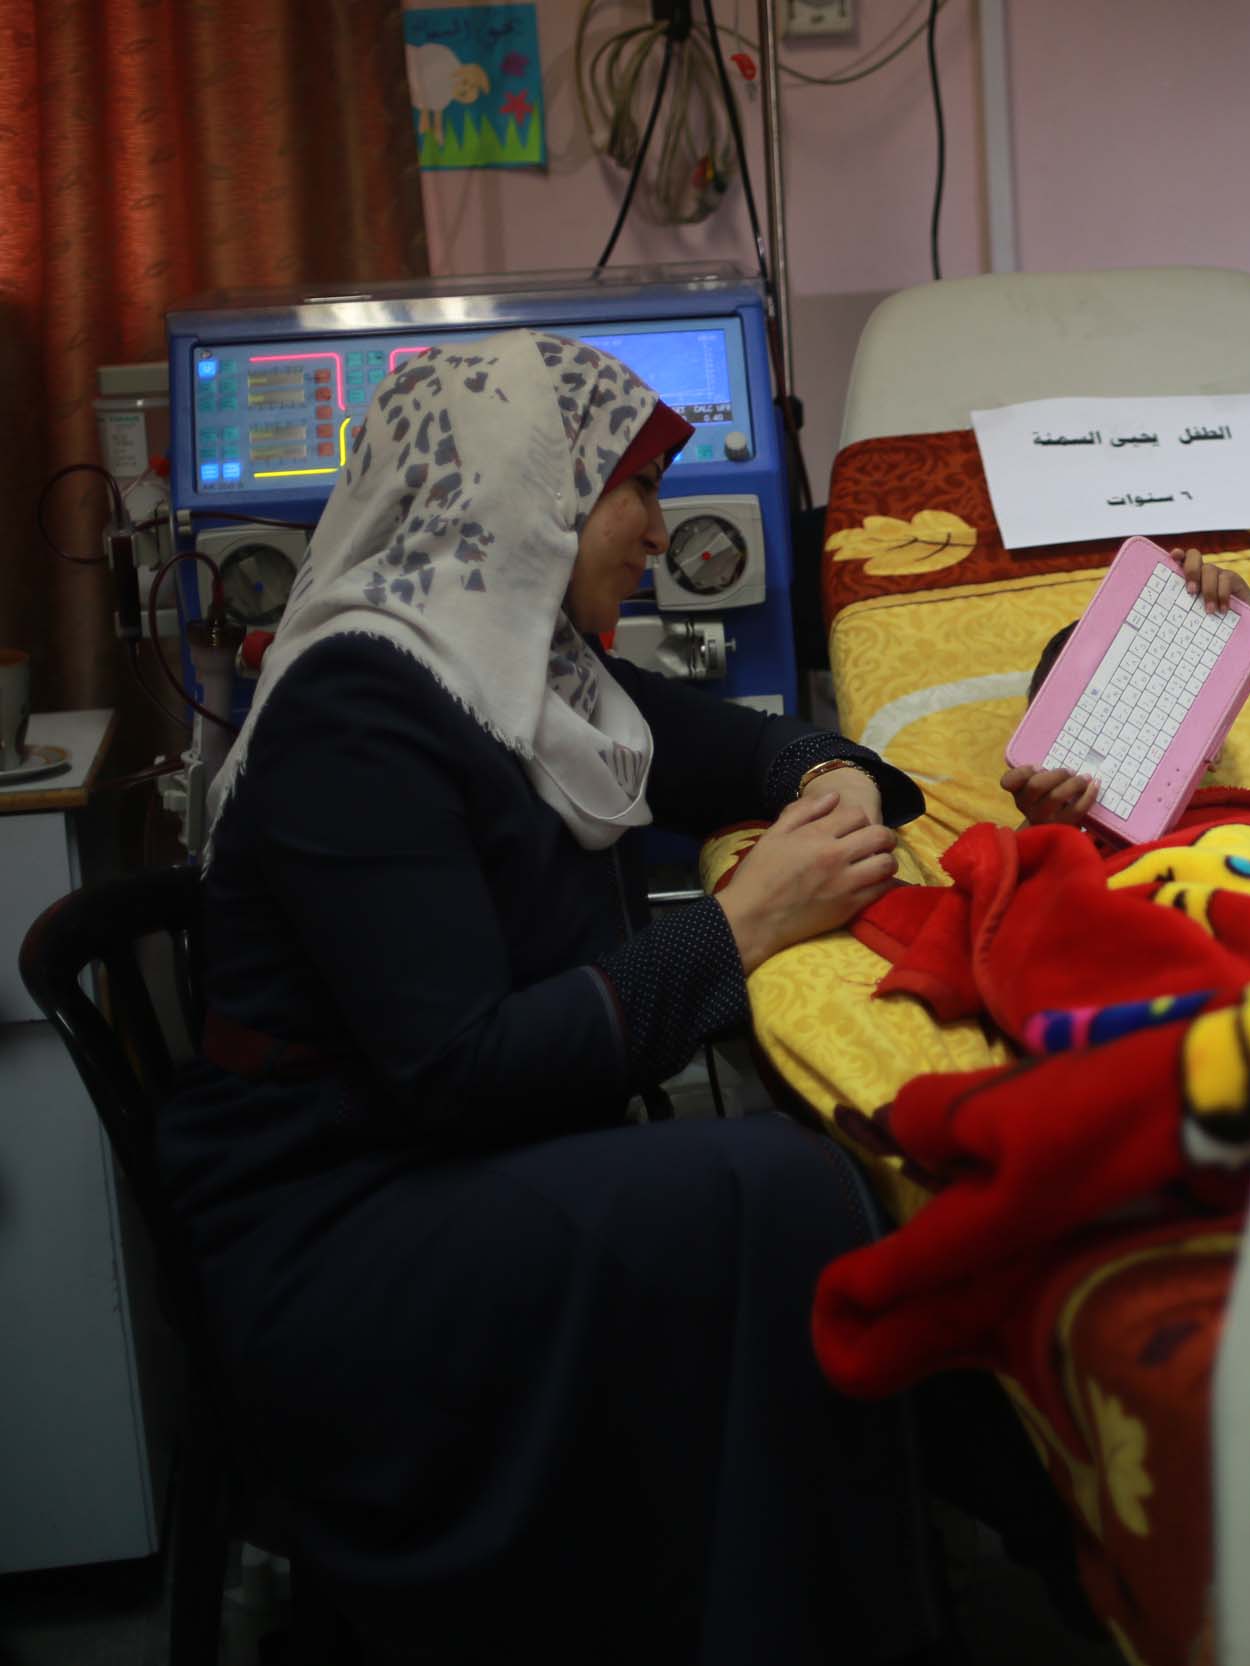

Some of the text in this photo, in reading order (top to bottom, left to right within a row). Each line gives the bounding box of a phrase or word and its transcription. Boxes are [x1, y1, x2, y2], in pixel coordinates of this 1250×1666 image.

[1178, 426, 1232, 445] الطفل
[1106, 490, 1193, 507] ٦ سنوات
